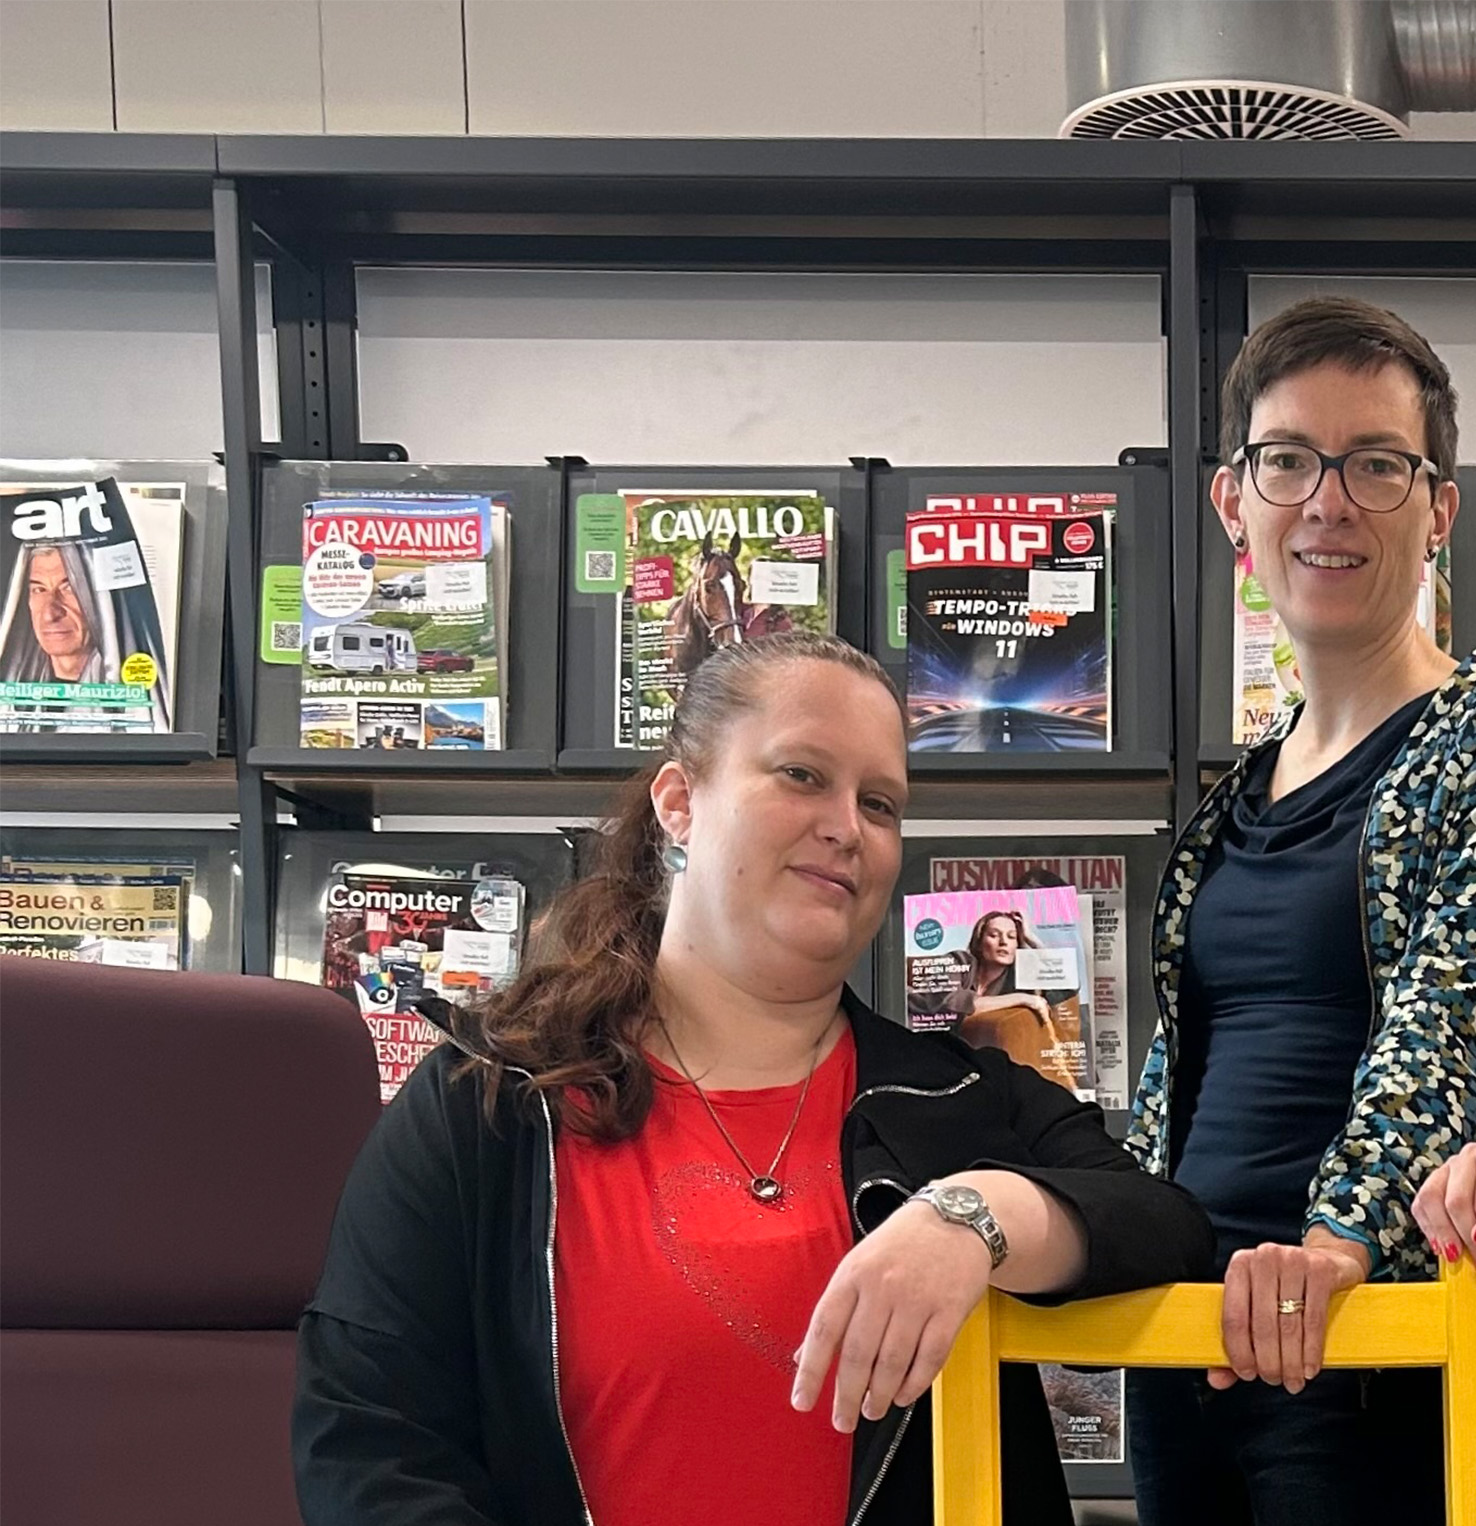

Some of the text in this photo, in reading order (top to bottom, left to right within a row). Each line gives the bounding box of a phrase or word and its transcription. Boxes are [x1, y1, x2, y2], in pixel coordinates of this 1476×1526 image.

[11, 482, 113, 540] art
[309, 519, 477, 547] CARAVANING
[651, 506, 803, 542] CAVALLO
[911, 523, 1047, 565] CHIP
[957, 619, 1055, 638] WINDOWS
[995, 640, 1018, 658] 11
[65, 684, 146, 699] Maurizio!
[304, 678, 343, 694] Fendt
[344, 679, 386, 696] Apero
[389, 678, 425, 694] Activ
[0, 889, 105, 910] Bauen &
[328, 884, 463, 914] Computer
[0, 910, 144, 932] Renovieren
